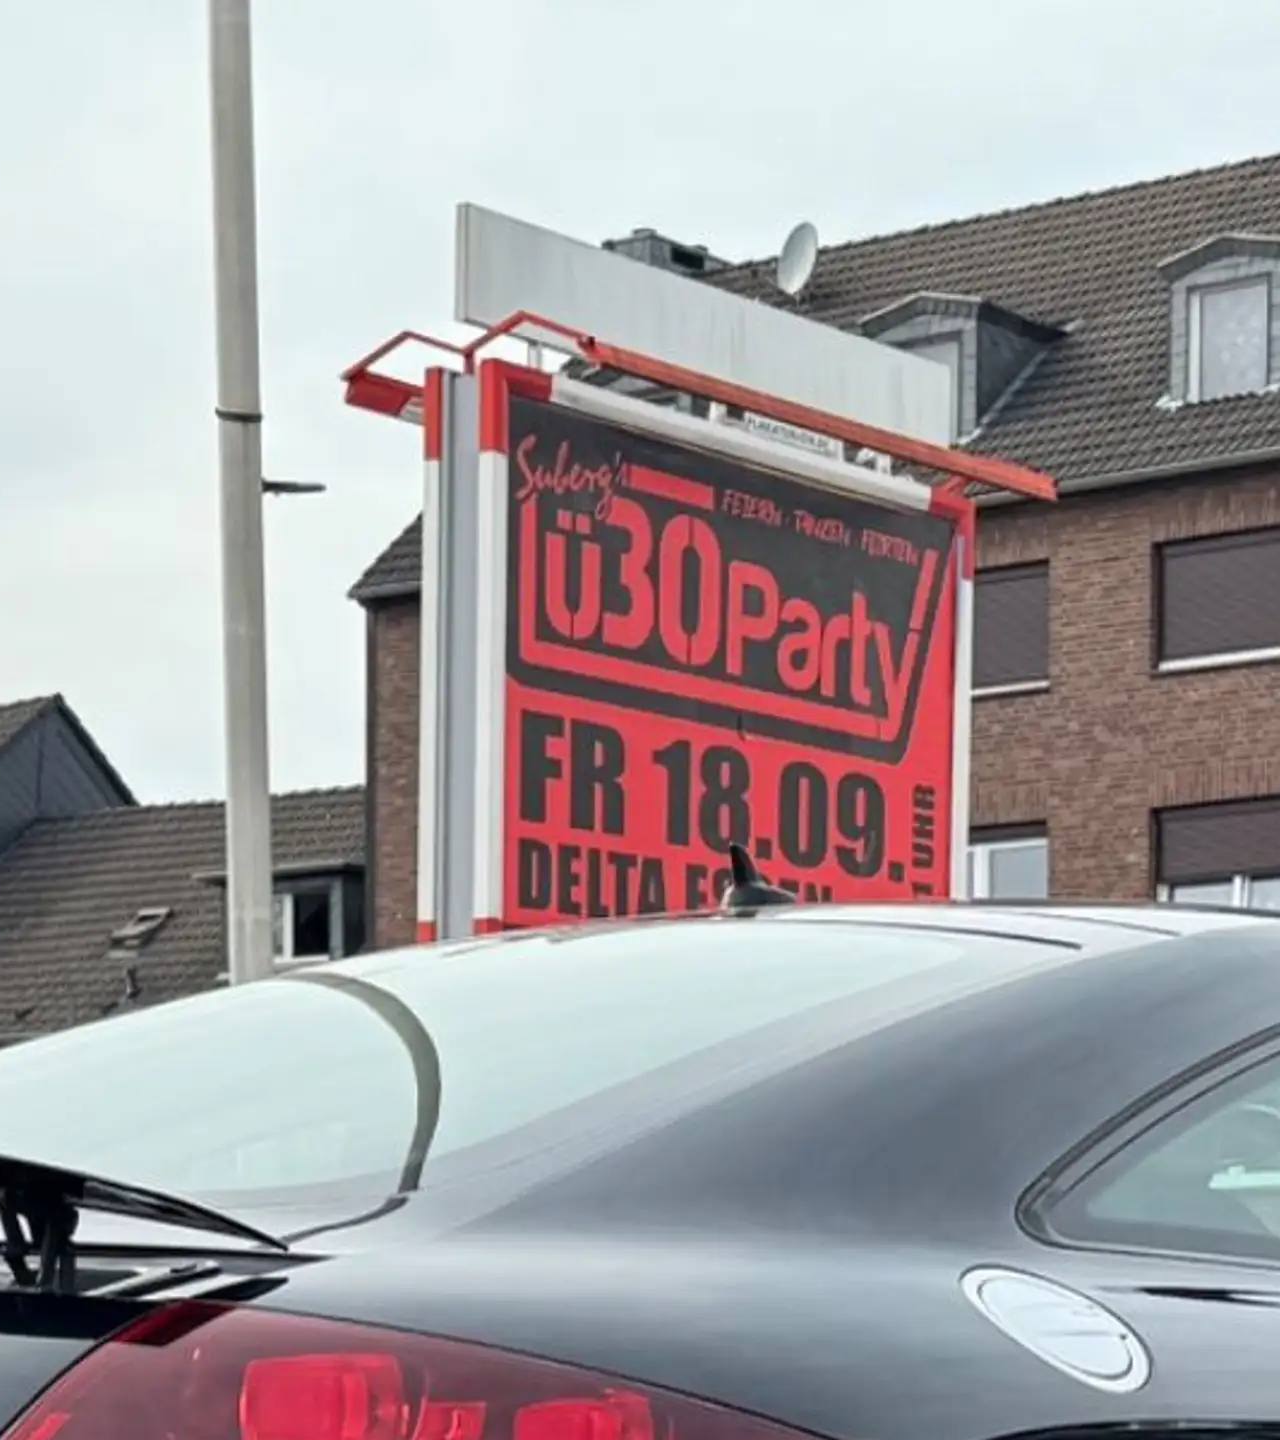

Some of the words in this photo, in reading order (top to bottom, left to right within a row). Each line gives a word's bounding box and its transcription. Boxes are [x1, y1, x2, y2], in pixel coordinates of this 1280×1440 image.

[521, 709, 626, 836] FR
[652, 738, 905, 882] 18.09.
[518, 838, 668, 919] DELTA
